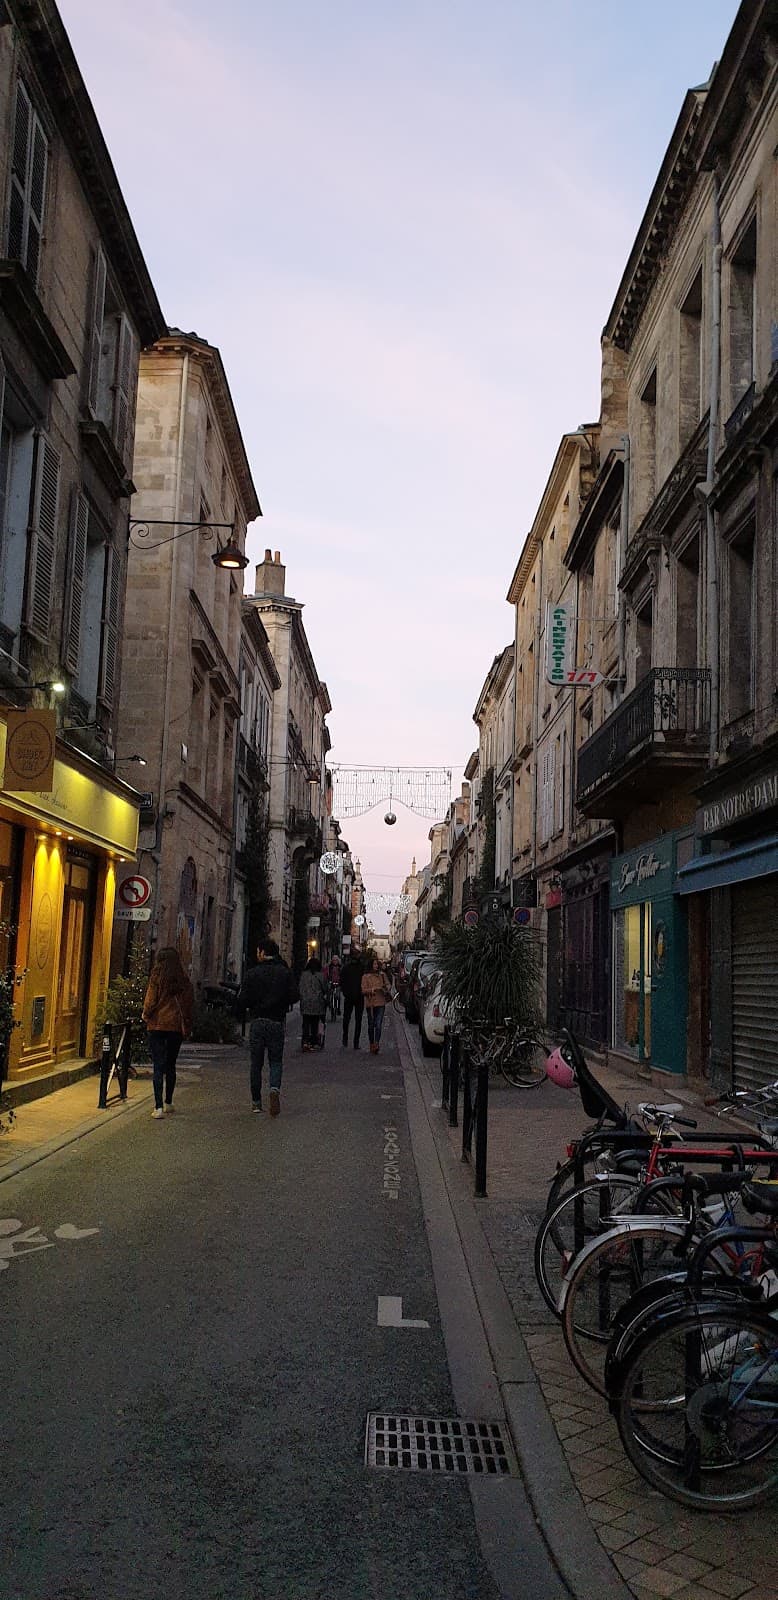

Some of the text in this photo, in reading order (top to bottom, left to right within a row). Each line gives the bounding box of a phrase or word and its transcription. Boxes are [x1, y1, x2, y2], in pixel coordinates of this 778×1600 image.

[552, 608, 566, 680] ALIMENTATION
[567, 671, 598, 682] 7/7
[703, 804, 720, 832] BAR
